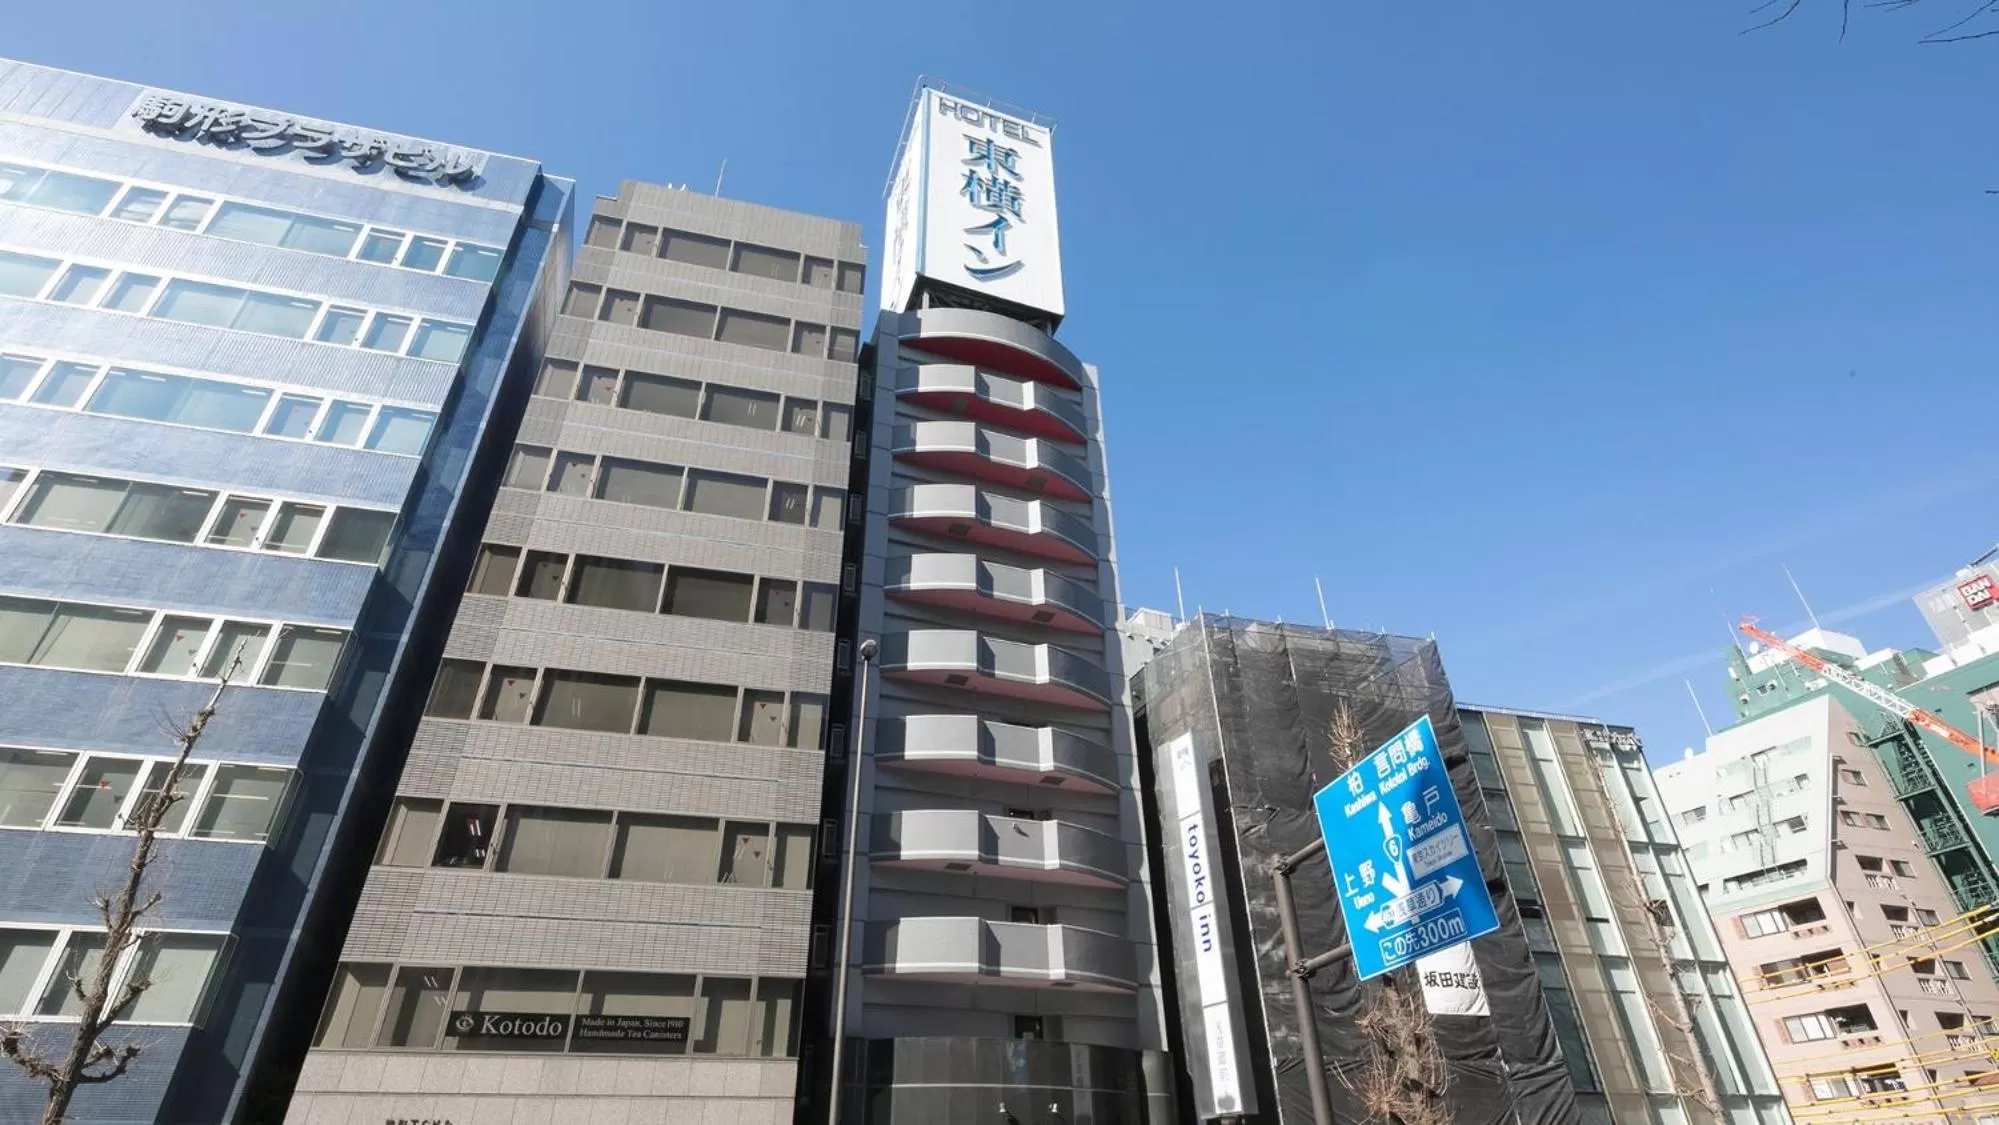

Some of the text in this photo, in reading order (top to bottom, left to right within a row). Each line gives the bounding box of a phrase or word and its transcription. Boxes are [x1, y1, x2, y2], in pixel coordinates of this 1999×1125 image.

[132, 95, 475, 184] 駒形プラザビル
[938, 97, 1048, 148] HOTEL
[960, 132, 1026, 282] 東横イン
[1373, 728, 1424, 777] 言問橋
[1407, 756, 1430, 778] Brdg.
[1401, 785, 1440, 825] 亀戸
[1407, 813, 1448, 841] Kameido
[1389, 841, 1399, 857] 6
[1187, 823, 1213, 953] toyoko inn
[1344, 859, 1376, 897] 上野
[1354, 892, 1375, 910] Ueno
[1383, 916, 1465, 960] この先300m
[480, 1015, 562, 1036] Kotodo
[580, 1028, 624, 1037] Handmade
[627, 1029, 641, 1038] Tea
[582, 1017, 604, 1026] Made
[607, 1018, 615, 1026] in
[643, 1019, 666, 1027] Since
